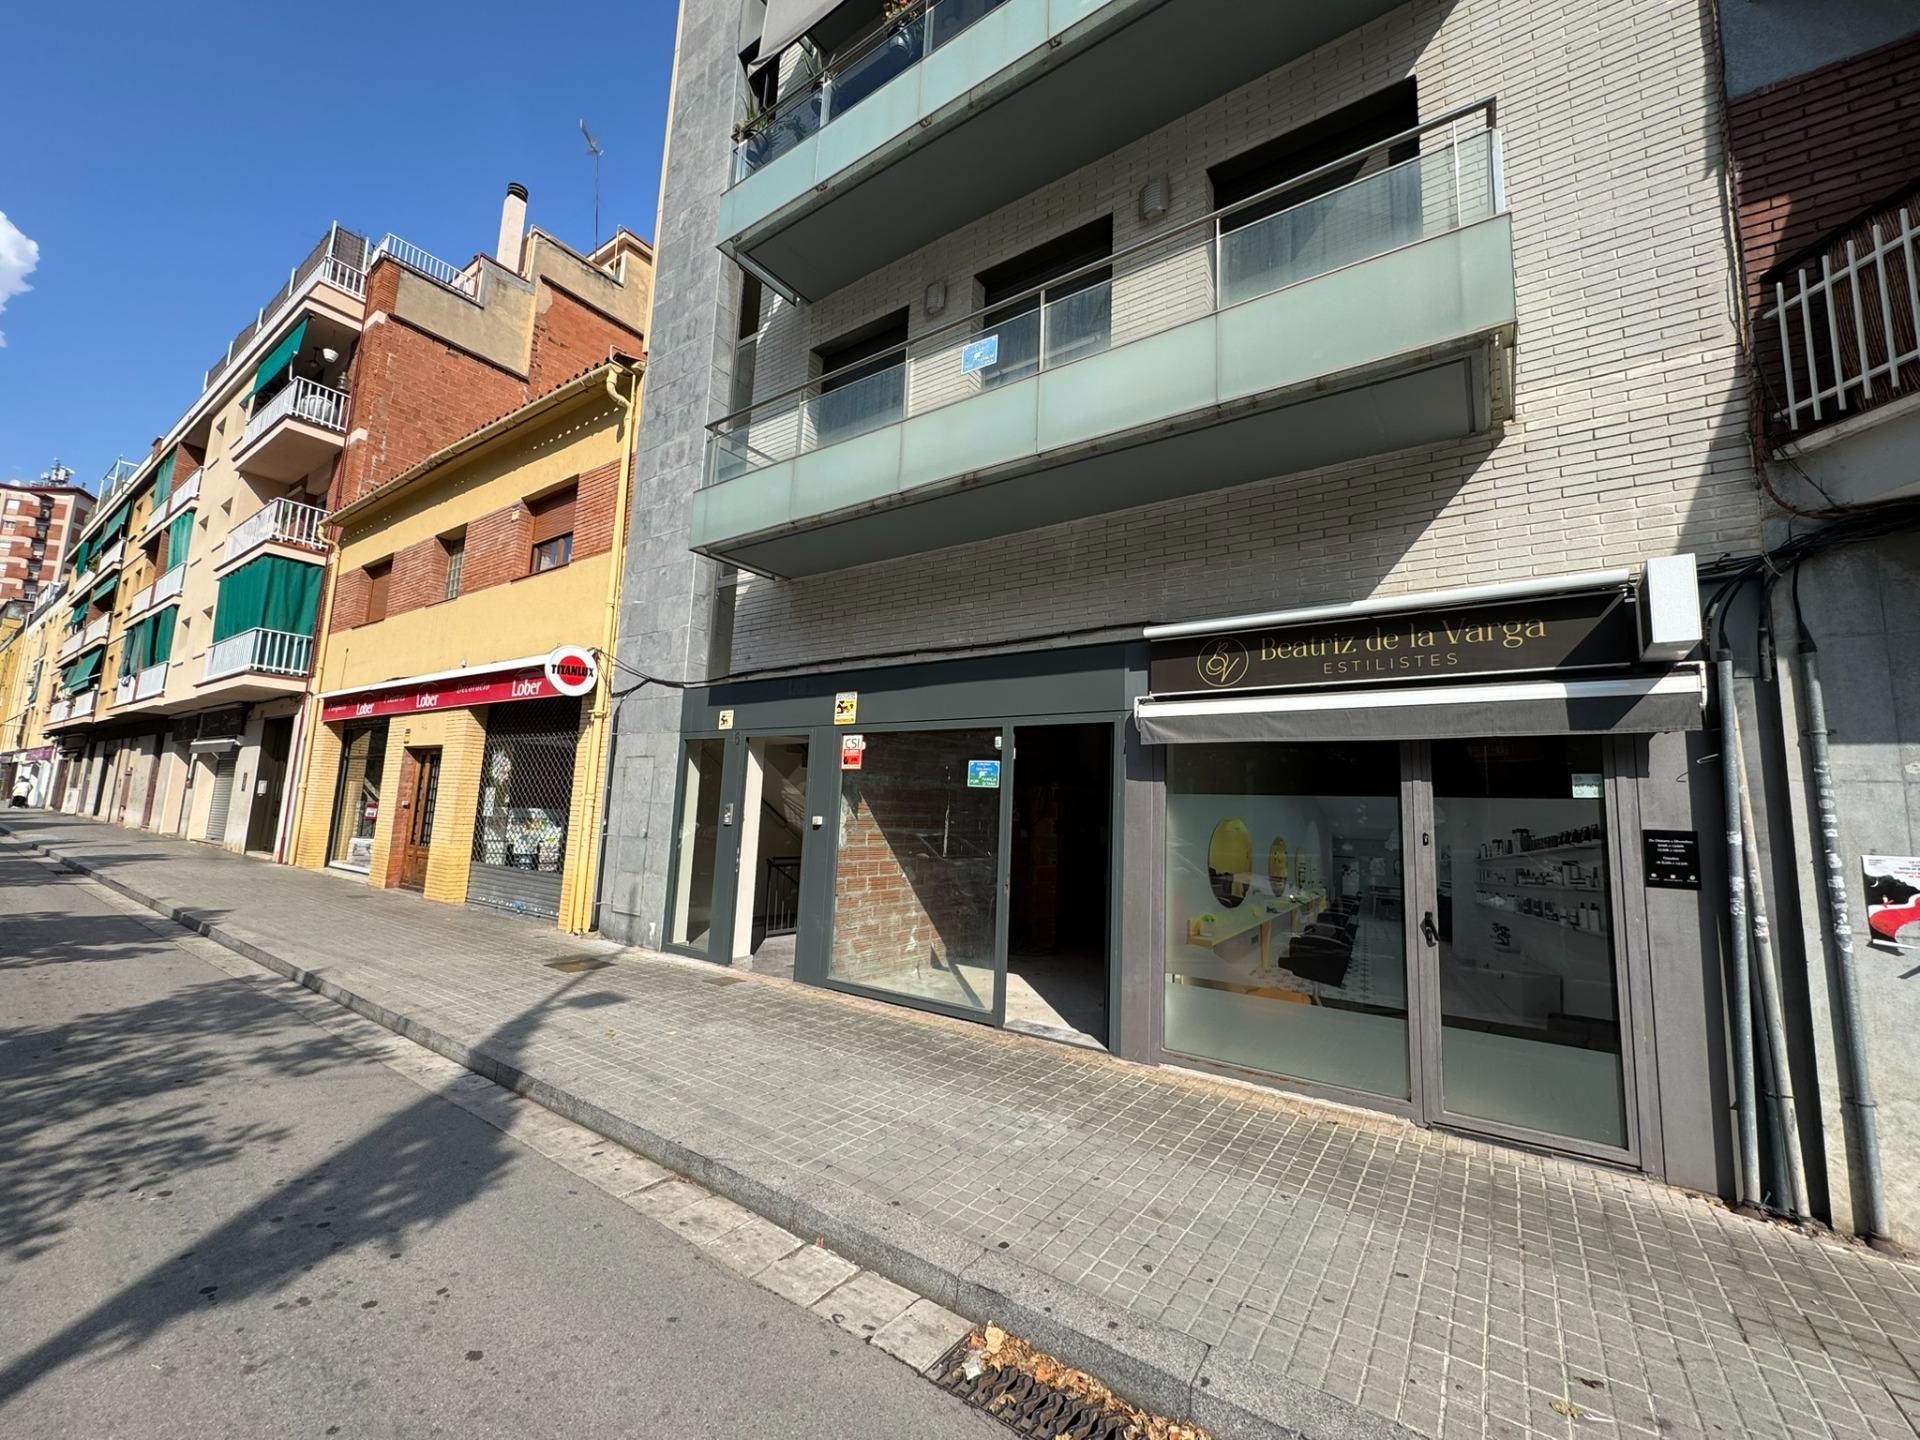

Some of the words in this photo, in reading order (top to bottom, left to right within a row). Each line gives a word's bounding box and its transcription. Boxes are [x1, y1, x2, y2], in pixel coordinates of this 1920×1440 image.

[1260, 632, 1357, 661] Beatriz
[1366, 626, 1399, 651] de
[1410, 623, 1436, 648] la
[1441, 617, 1547, 648] Varga
[551, 664, 595, 678] TITANLUX
[1323, 652, 1458, 674] ESTILISTES
[511, 679, 542, 697] Lober
[416, 692, 439, 708] Lober
[356, 702, 374, 716] Lober
